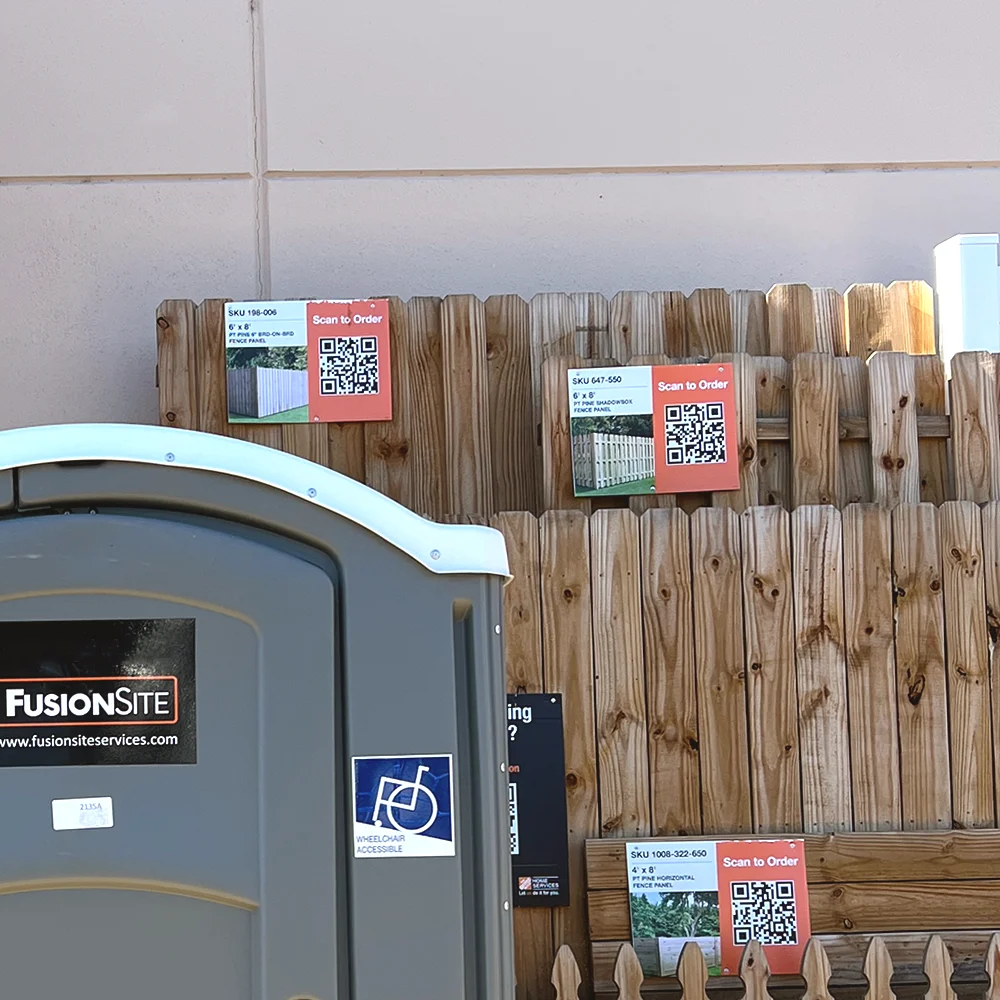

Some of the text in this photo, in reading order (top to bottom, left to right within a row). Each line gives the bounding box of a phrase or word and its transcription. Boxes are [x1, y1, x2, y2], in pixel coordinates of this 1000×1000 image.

[312, 314, 383, 325] Scan to Order
[572, 376, 622, 385] SKU 647-550
[658, 380, 728, 391] Scan to Order
[356, 835, 405, 843] WHEELCHAIR
[356, 845, 403, 853] ACCESSIBLE
[631, 850, 707, 859] SKU 1008-322-650
[723, 856, 799, 867] Scan to Order
